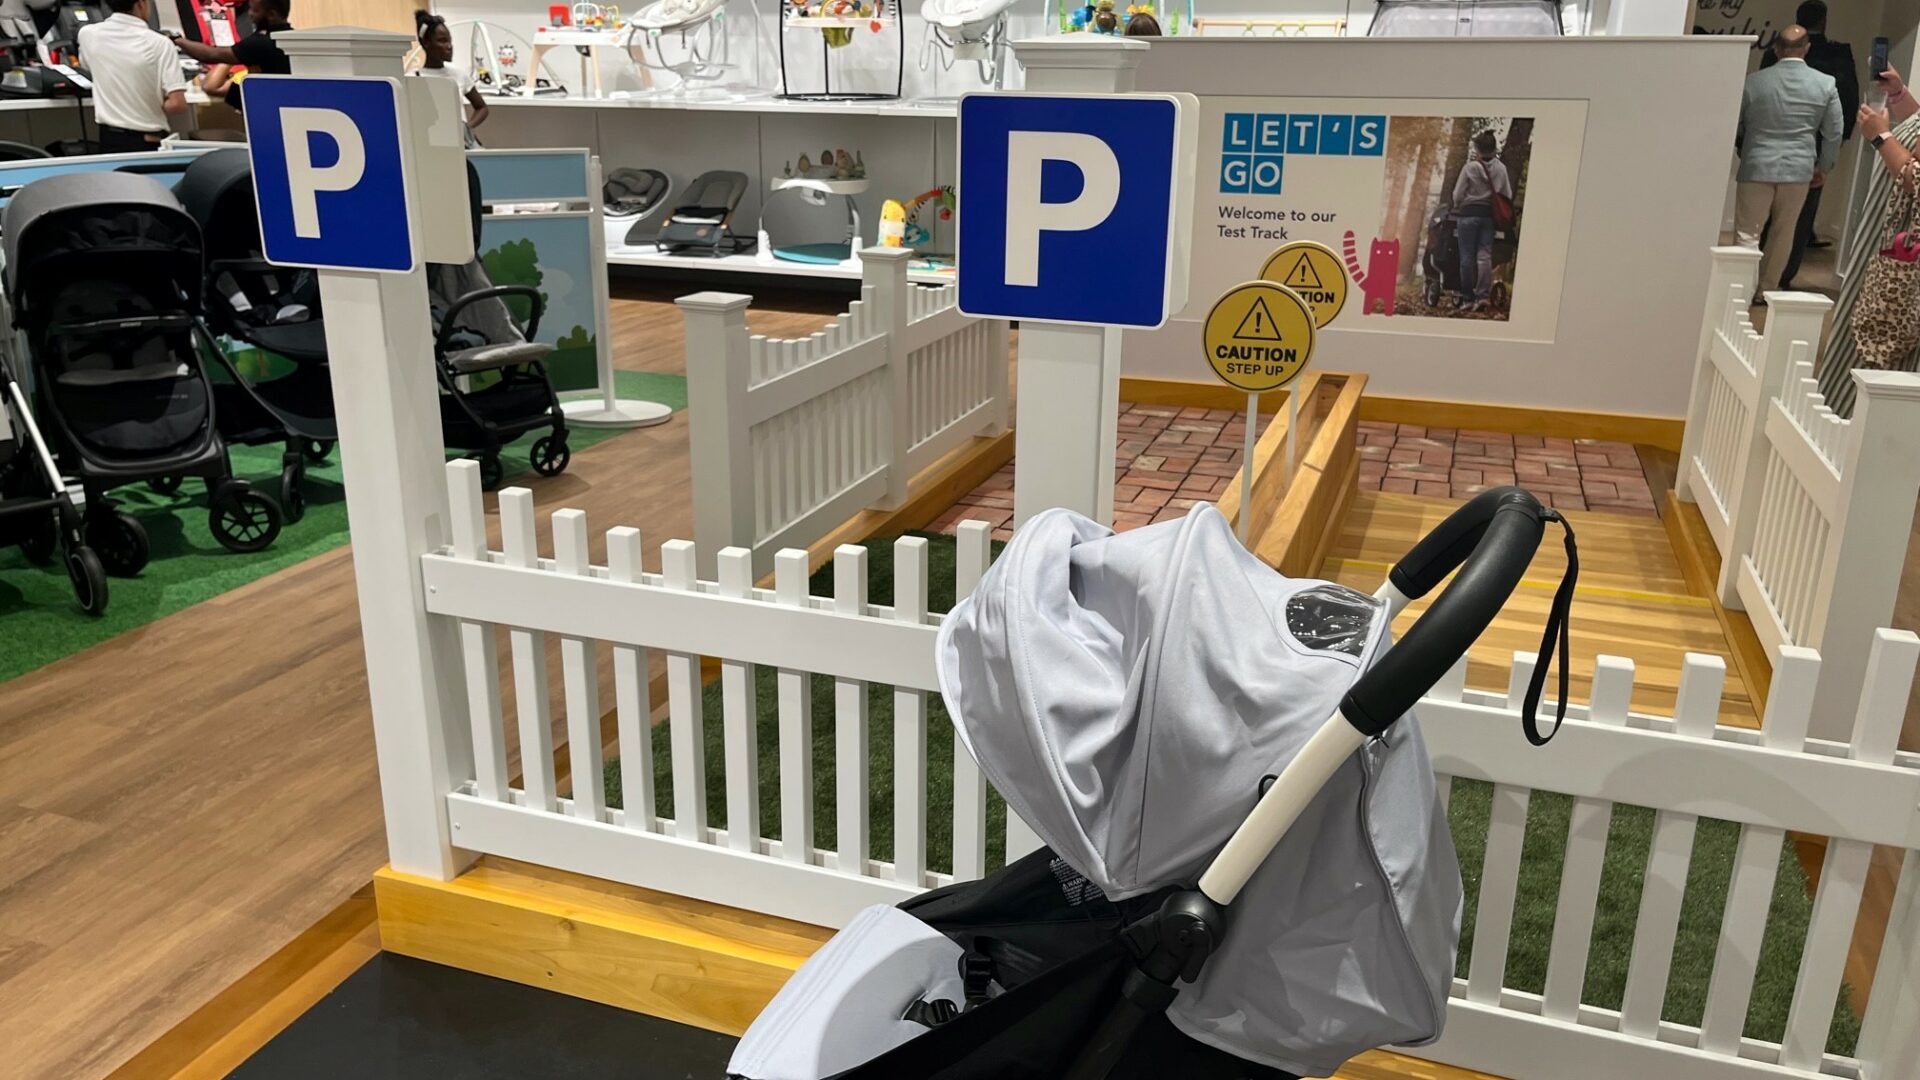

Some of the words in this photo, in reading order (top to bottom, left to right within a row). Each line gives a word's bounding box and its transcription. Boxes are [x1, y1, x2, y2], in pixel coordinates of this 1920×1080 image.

[1231, 120, 1378, 149] LET'S
[279, 107, 366, 239] P
[1223, 160, 1281, 188] GO
[1004, 130, 1121, 287] P
[1218, 206, 1286, 221] Welcome
[1290, 210, 1306, 222] to
[1311, 212, 1336, 222] our
[1217, 225, 1246, 238] Test
[1250, 226, 1288, 240] Track
[1297, 291, 1335, 304] TION
[1216, 345, 1297, 362] CAUTION
[1226, 363, 1261, 375] STEP
[1265, 365, 1284, 376] UP
